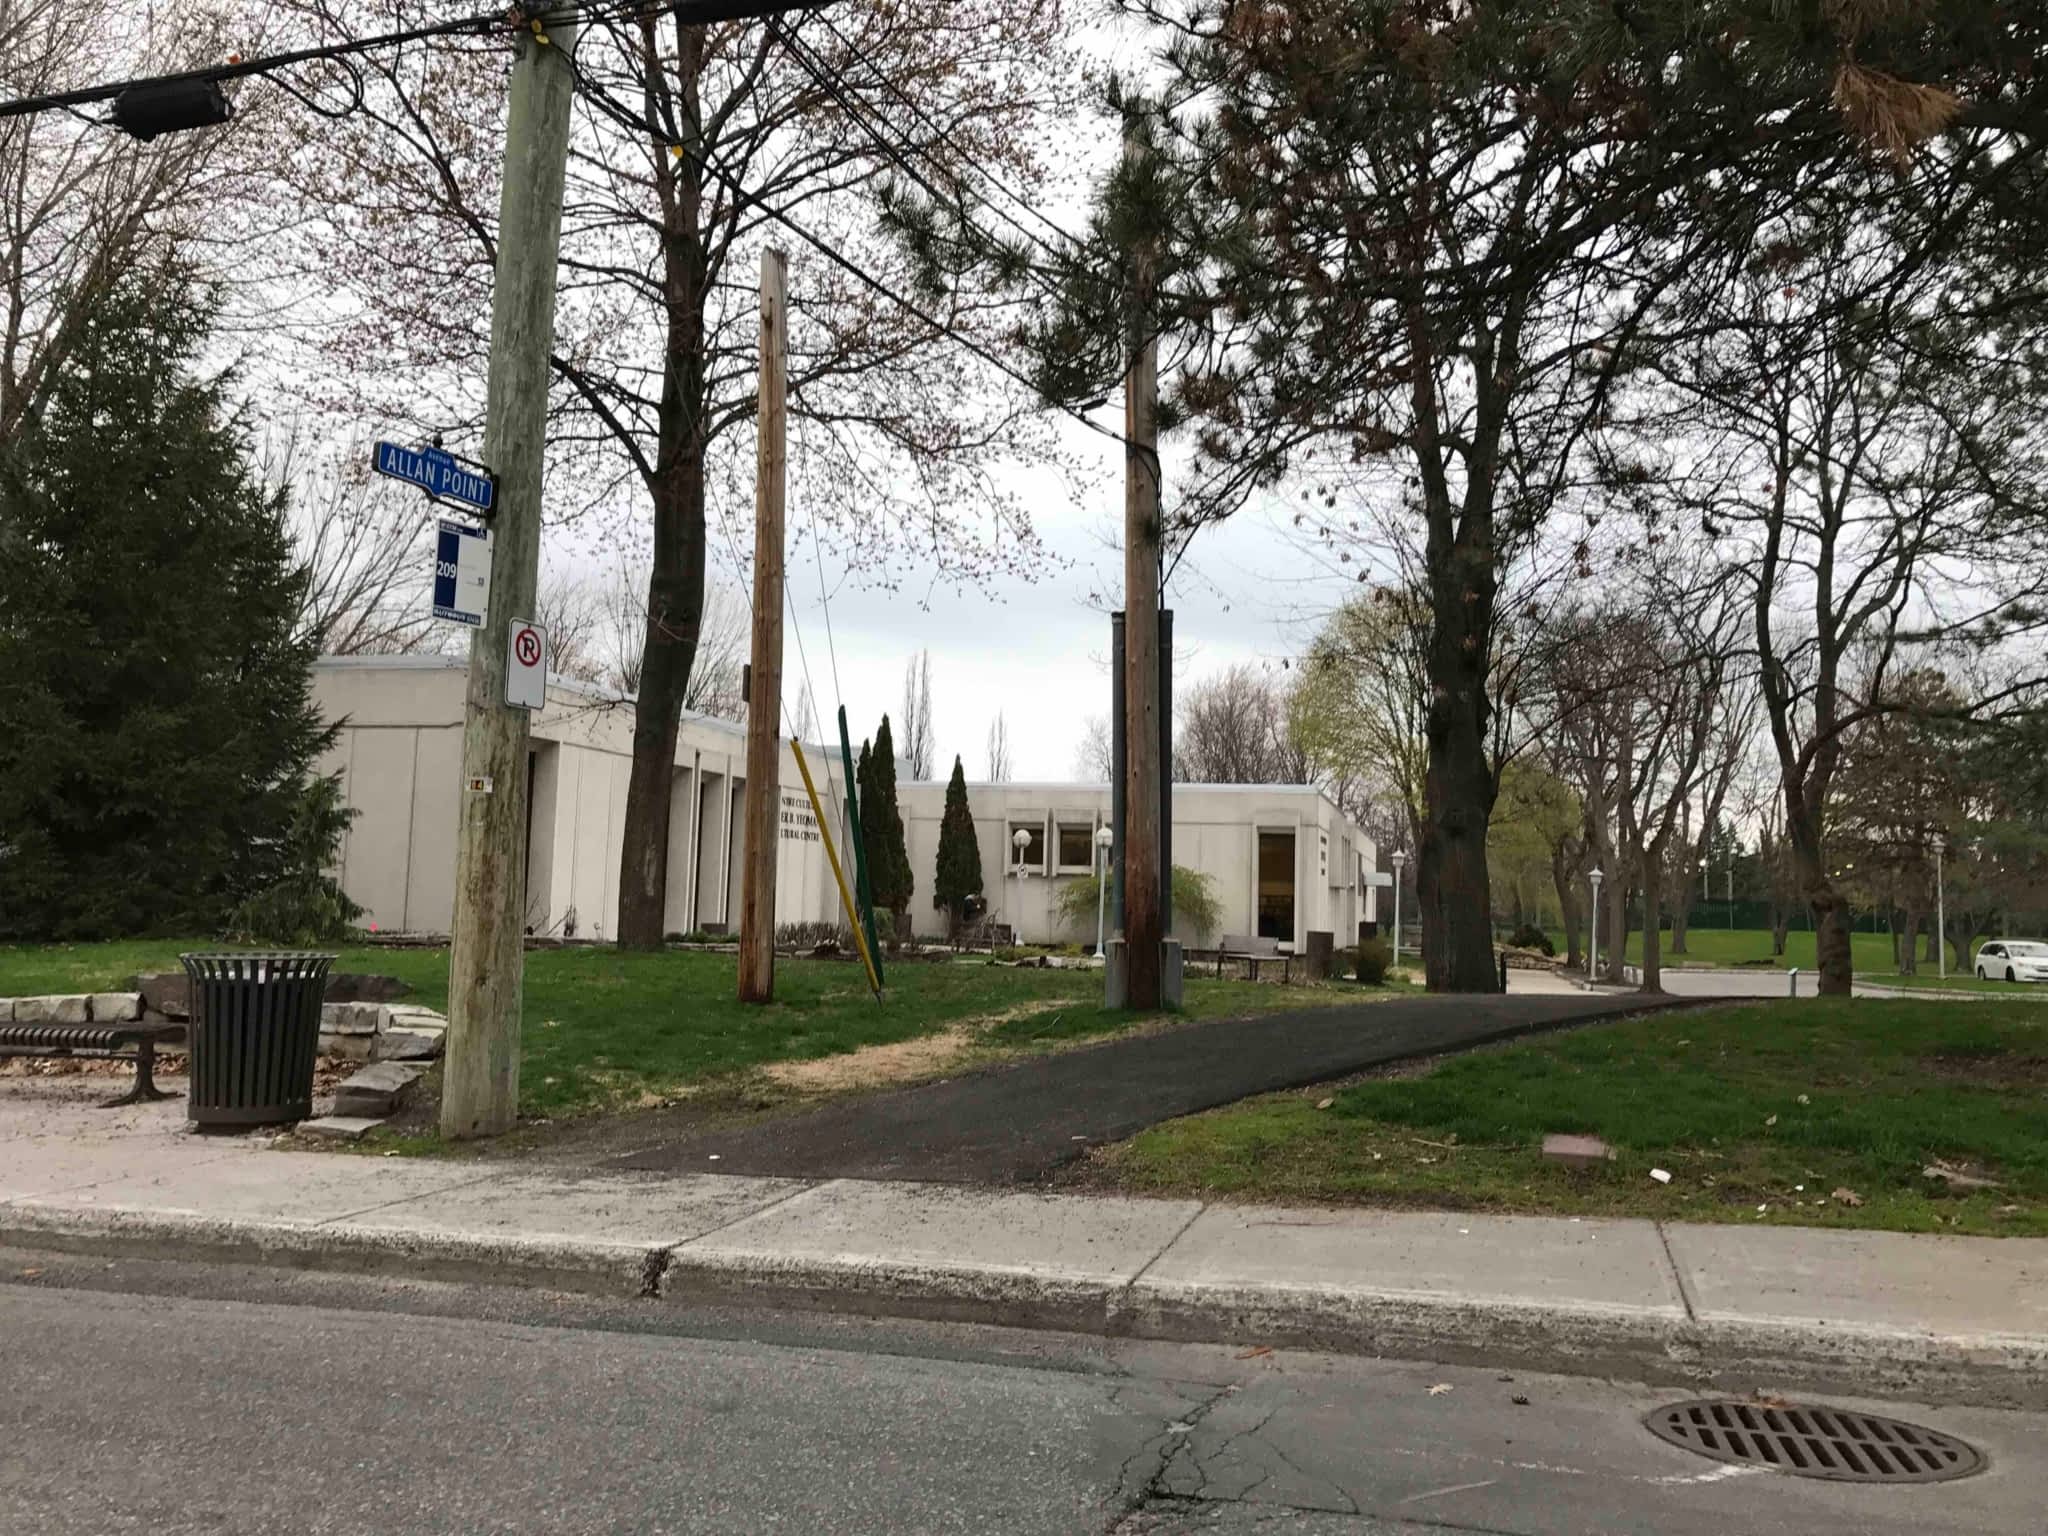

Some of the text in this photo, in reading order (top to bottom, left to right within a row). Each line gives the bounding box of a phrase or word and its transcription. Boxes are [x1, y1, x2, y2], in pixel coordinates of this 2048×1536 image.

[428, 450, 451, 465] Avenue
[386, 447, 486, 502] ALLAN POINT
[436, 560, 457, 579] 209
